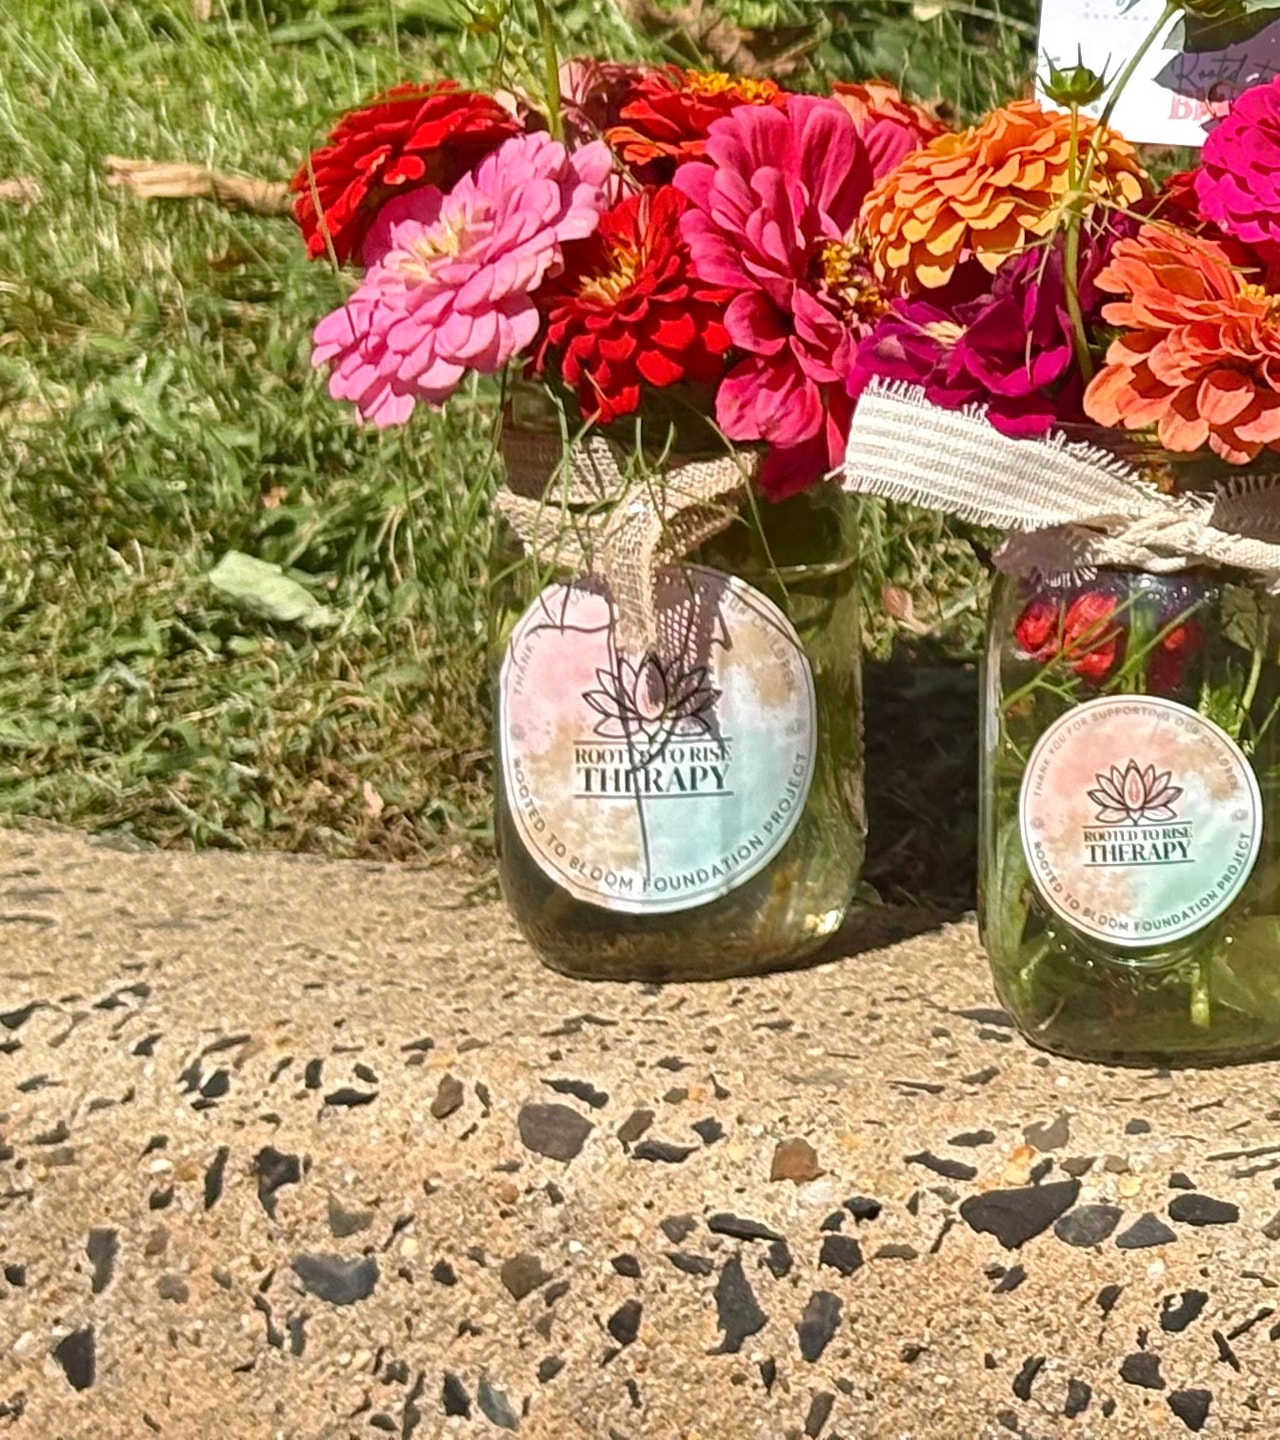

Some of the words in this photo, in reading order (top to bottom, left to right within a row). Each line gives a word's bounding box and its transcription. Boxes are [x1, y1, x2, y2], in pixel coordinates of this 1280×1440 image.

[1049, 733, 1067, 755] YOU
[1067, 718, 1089, 737] FOR
[1091, 705, 1171, 723] SUPPORTING
[689, 744, 733, 764] RISE
[576, 764, 731, 794] THERAPY
[512, 757, 546, 834] ROOTED
[547, 832, 567, 858] TO
[568, 855, 634, 893] BLOOM
[641, 835, 764, 893] FOUNDATION
[763, 751, 810, 834] PROJECT
[1083, 830, 1139, 843] ROOTED
[1140, 828, 1160, 841] TO
[1161, 826, 1194, 840] RISE
[1084, 840, 1192, 864] THERAPY
[1033, 840, 1064, 895] ROOTED
[1064, 893, 1081, 910] TO
[1082, 906, 1129, 933] BLOOM
[1133, 891, 1220, 933] FOUNDATION
[1217, 832, 1251, 892] PROJECT
